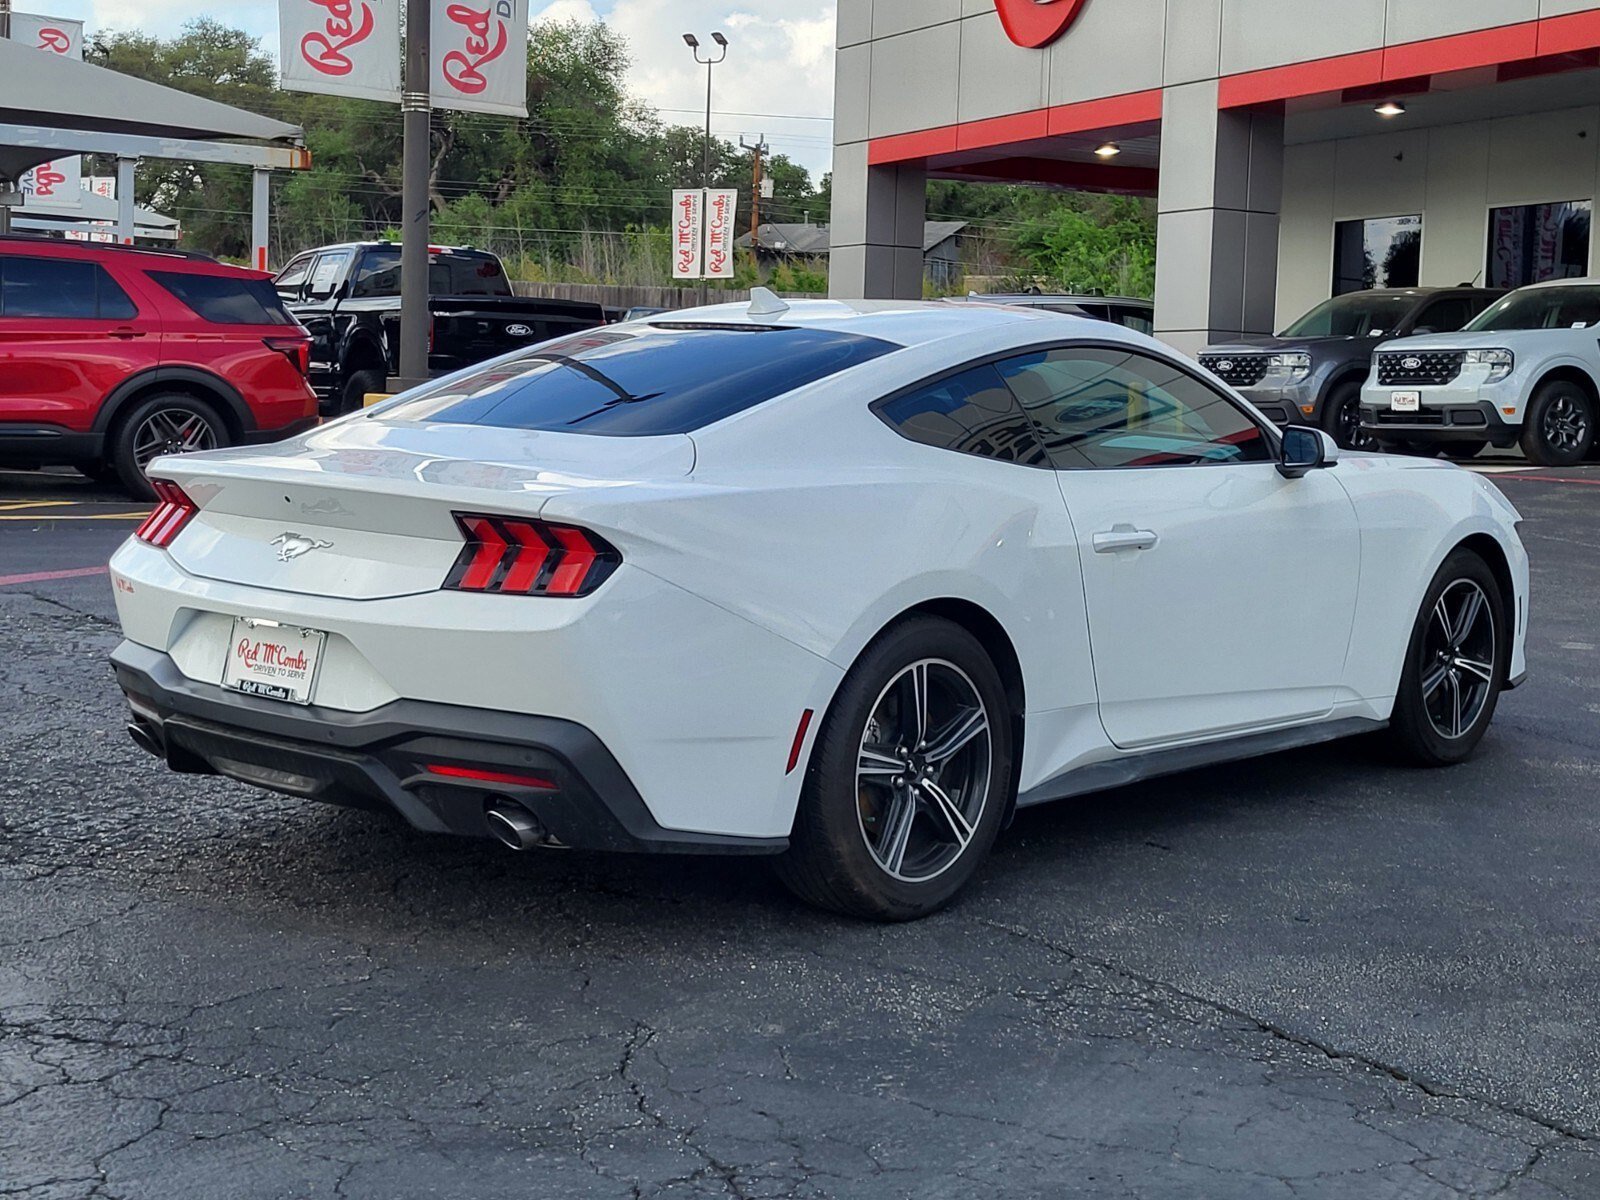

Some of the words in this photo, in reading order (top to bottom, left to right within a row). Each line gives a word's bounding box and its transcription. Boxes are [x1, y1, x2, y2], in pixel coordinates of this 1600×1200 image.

[442, 4, 507, 94] Red
[678, 194, 692, 247] McCombs
[710, 194, 725, 247] McCombs
[677, 249, 695, 273] Red
[709, 249, 726, 273] Red
[237, 638, 260, 668] Red
[262, 643, 308, 671] McCombs
[253, 664, 277, 675] DRIVEN
[277, 667, 287, 676] TO
[287, 670, 306, 680] SERVE
